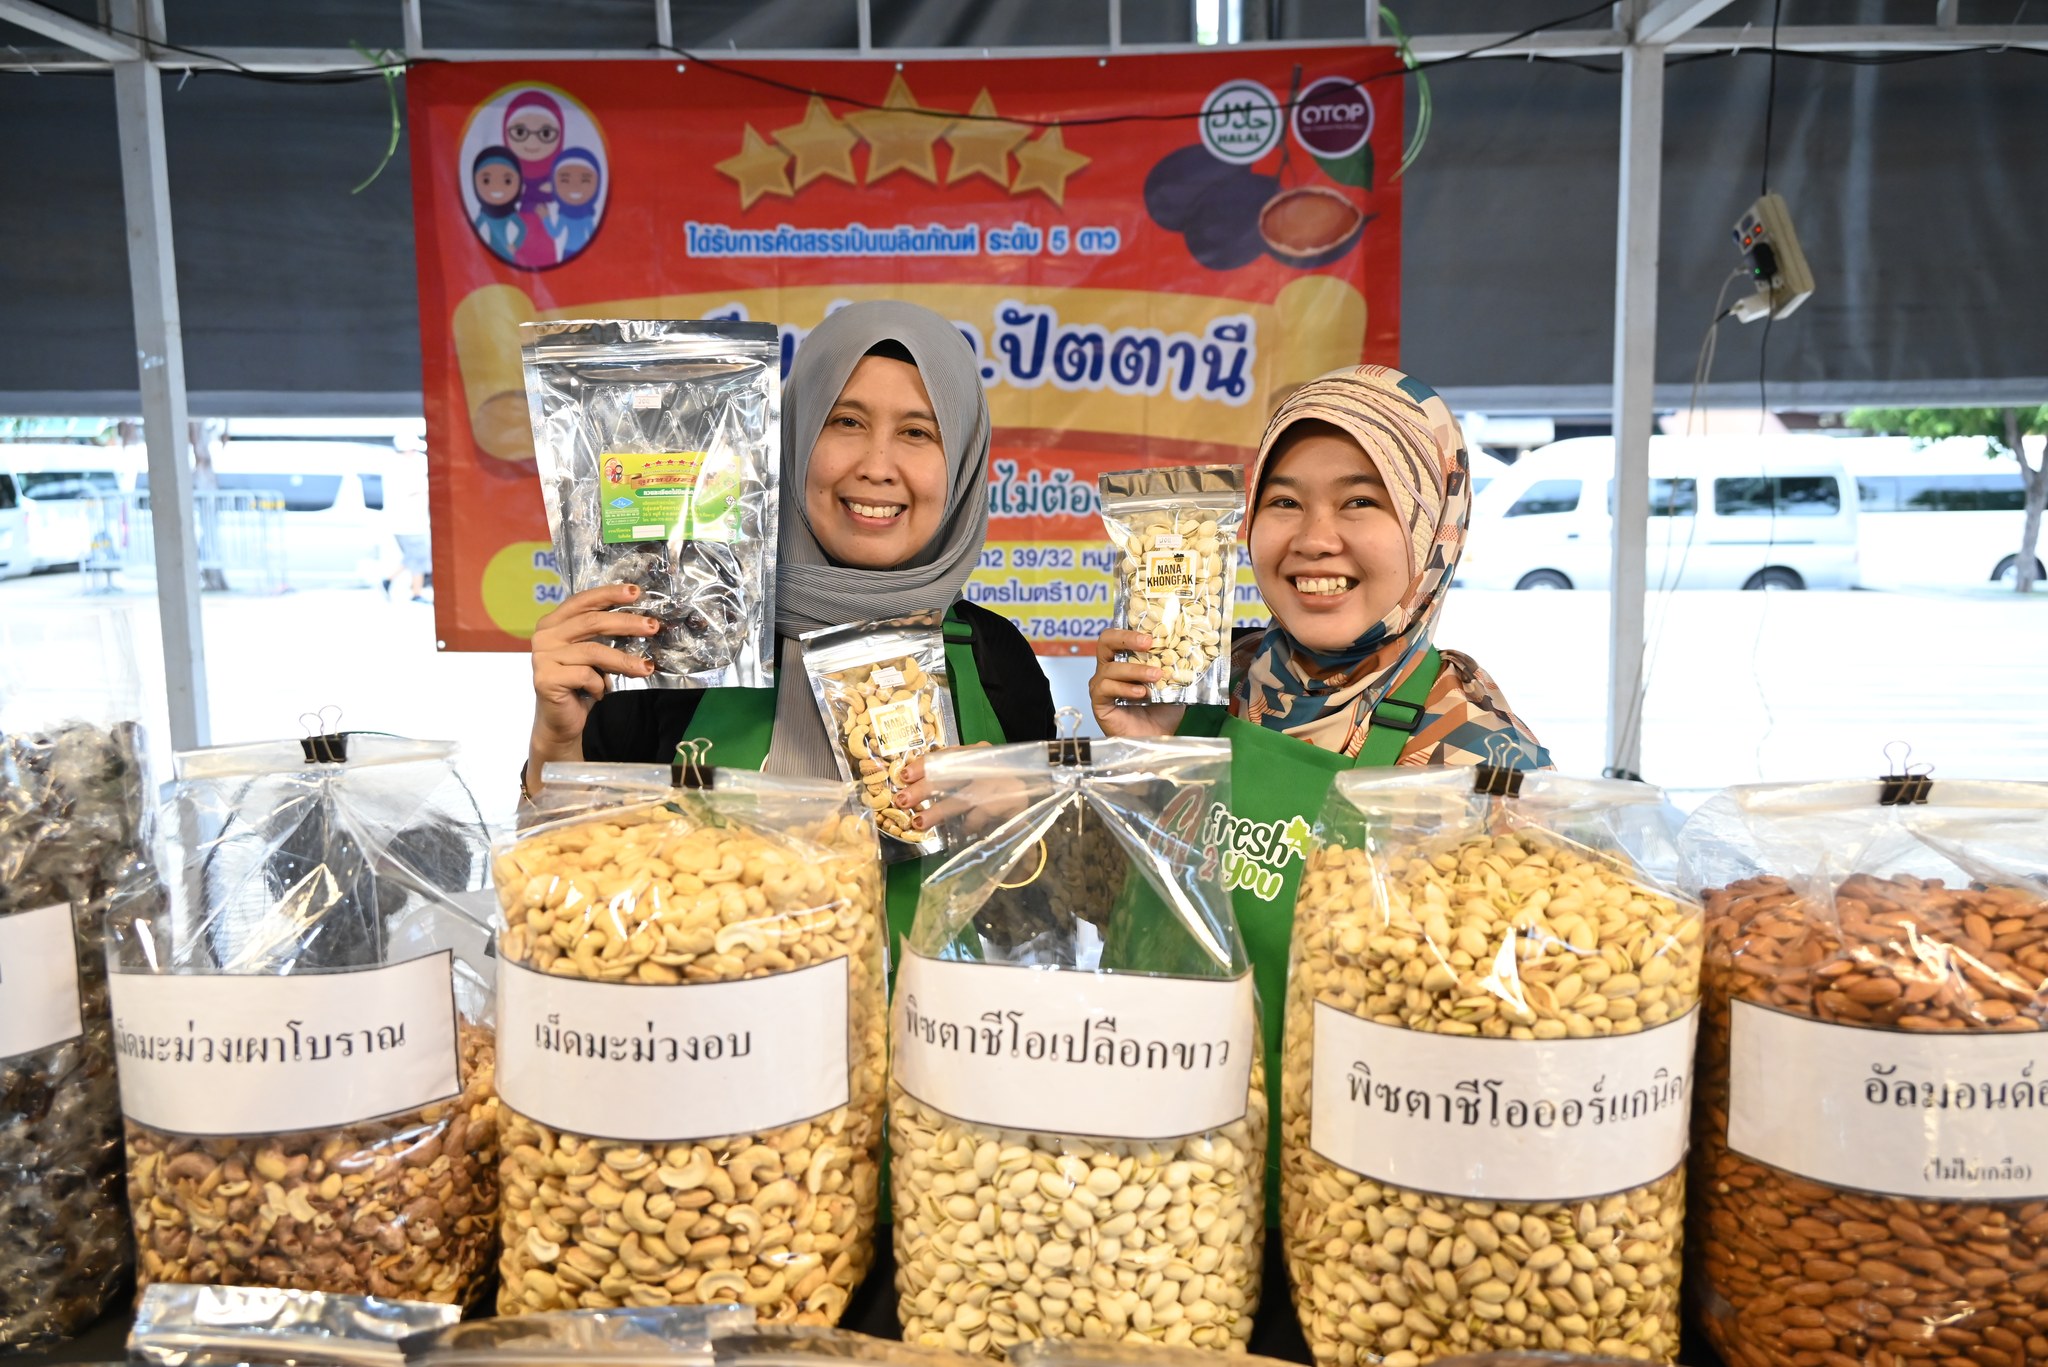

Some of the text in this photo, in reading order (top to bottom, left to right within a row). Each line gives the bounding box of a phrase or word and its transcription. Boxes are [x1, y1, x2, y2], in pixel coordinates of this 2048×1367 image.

[1302, 103, 1365, 124] OTOP
[1217, 133, 1261, 144] HALAL
[987, 223, 1041, 253] ระดับ
[1050, 228, 1068, 252] 5
[1078, 227, 1119, 252] ดาว
[960, 307, 1248, 398] .ปัตตานี
[1013, 549, 1073, 568] 39/32
[1157, 564, 1182, 575] NANA
[1147, 575, 1194, 588] KHONGFAK
[1203, 802, 1290, 867] fresh
[1222, 849, 1284, 901] you
[116, 1018, 406, 1064] ม็ดมะม่วงเผาโบราณ
[535, 1012, 752, 1063] เม็ดมะม่วงอบ
[904, 993, 1231, 1070] พิซตาชีโอเปลือกขาว
